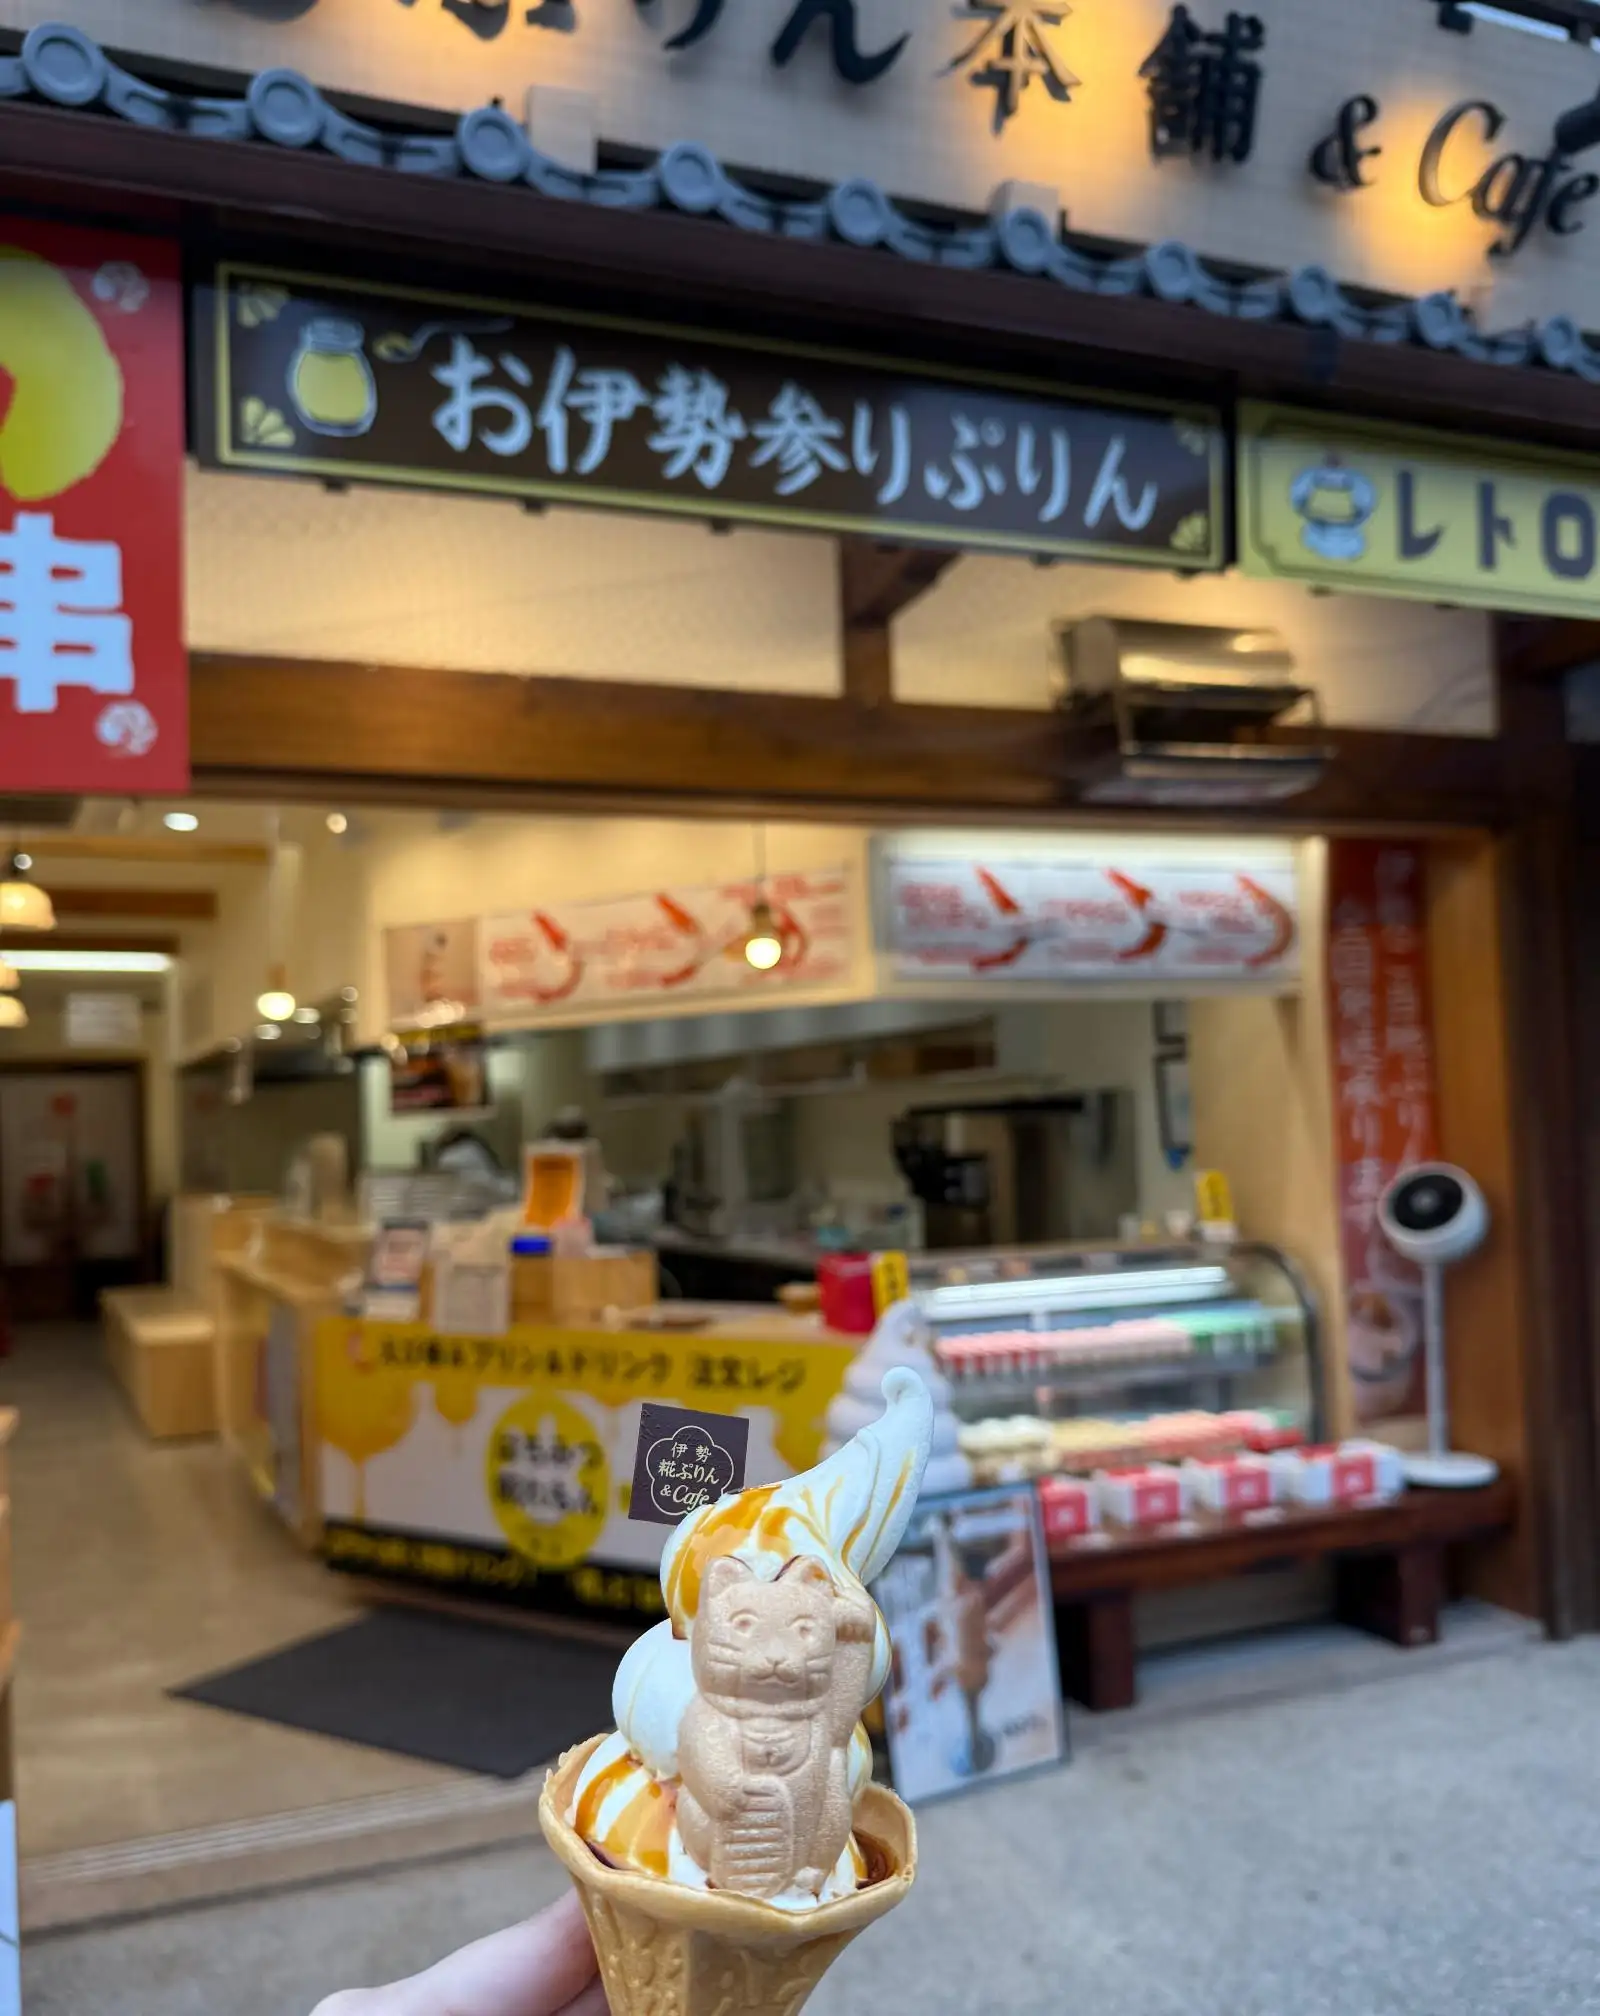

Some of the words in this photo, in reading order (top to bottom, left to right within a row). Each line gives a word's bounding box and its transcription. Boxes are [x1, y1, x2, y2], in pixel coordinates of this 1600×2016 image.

[431, 333, 1158, 531] お伊勢参りぷりん
[671, 1441, 712, 1463] 伊勢
[658, 1458, 720, 1485] 糀ぷりん
